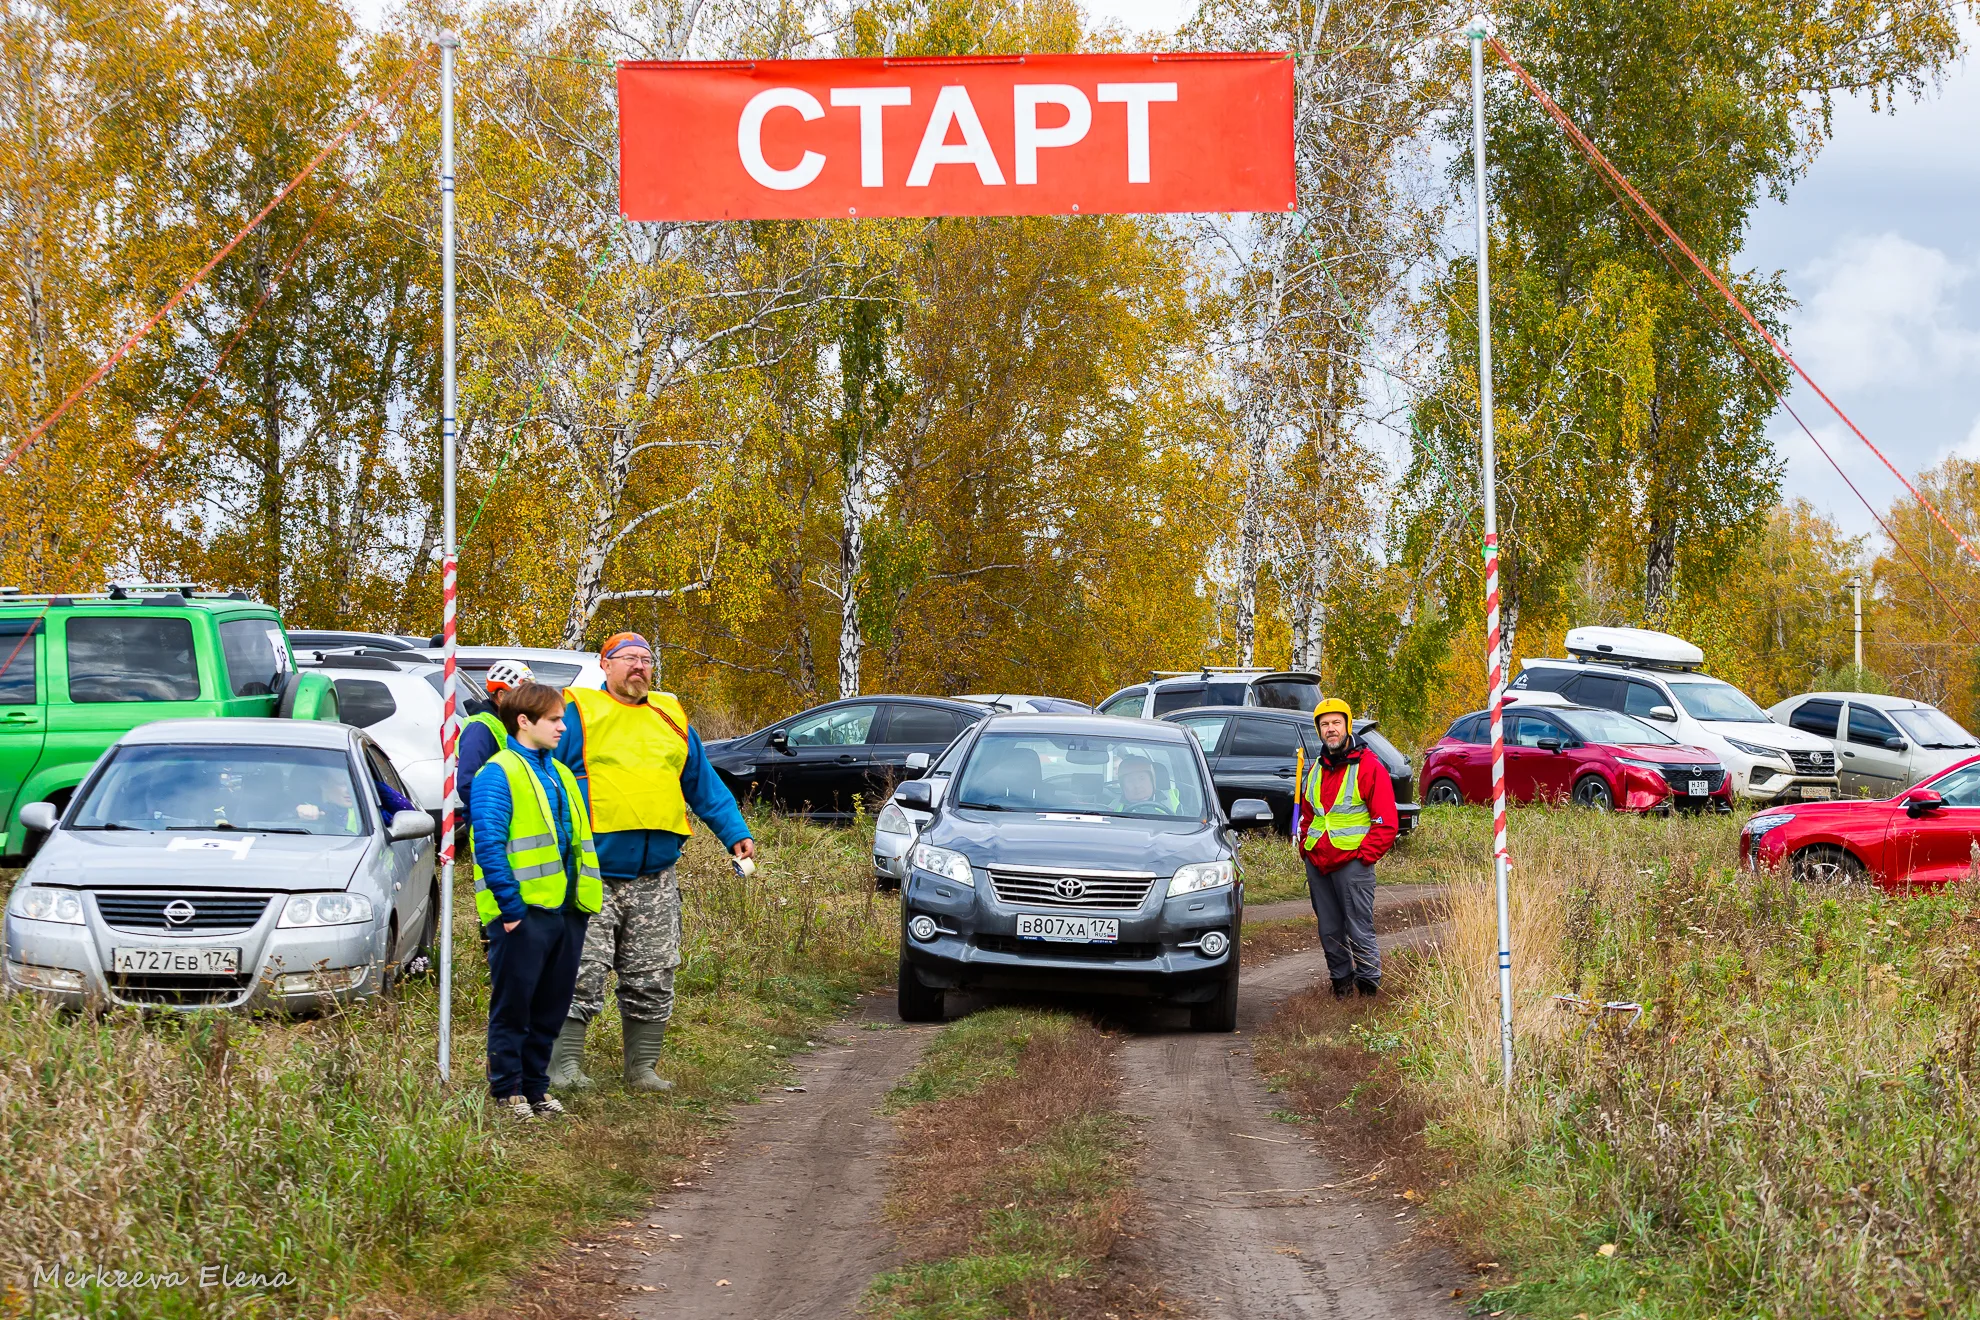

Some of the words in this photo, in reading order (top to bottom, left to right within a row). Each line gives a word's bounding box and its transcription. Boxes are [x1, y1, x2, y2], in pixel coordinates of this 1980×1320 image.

[738, 82, 1178, 190] СТАРТ
[1022, 918, 1086, 936] В807ХА
[1090, 920, 1114, 933] 174
[123, 951, 198, 970] А727ЕВ
[203, 952, 231, 966] 174
